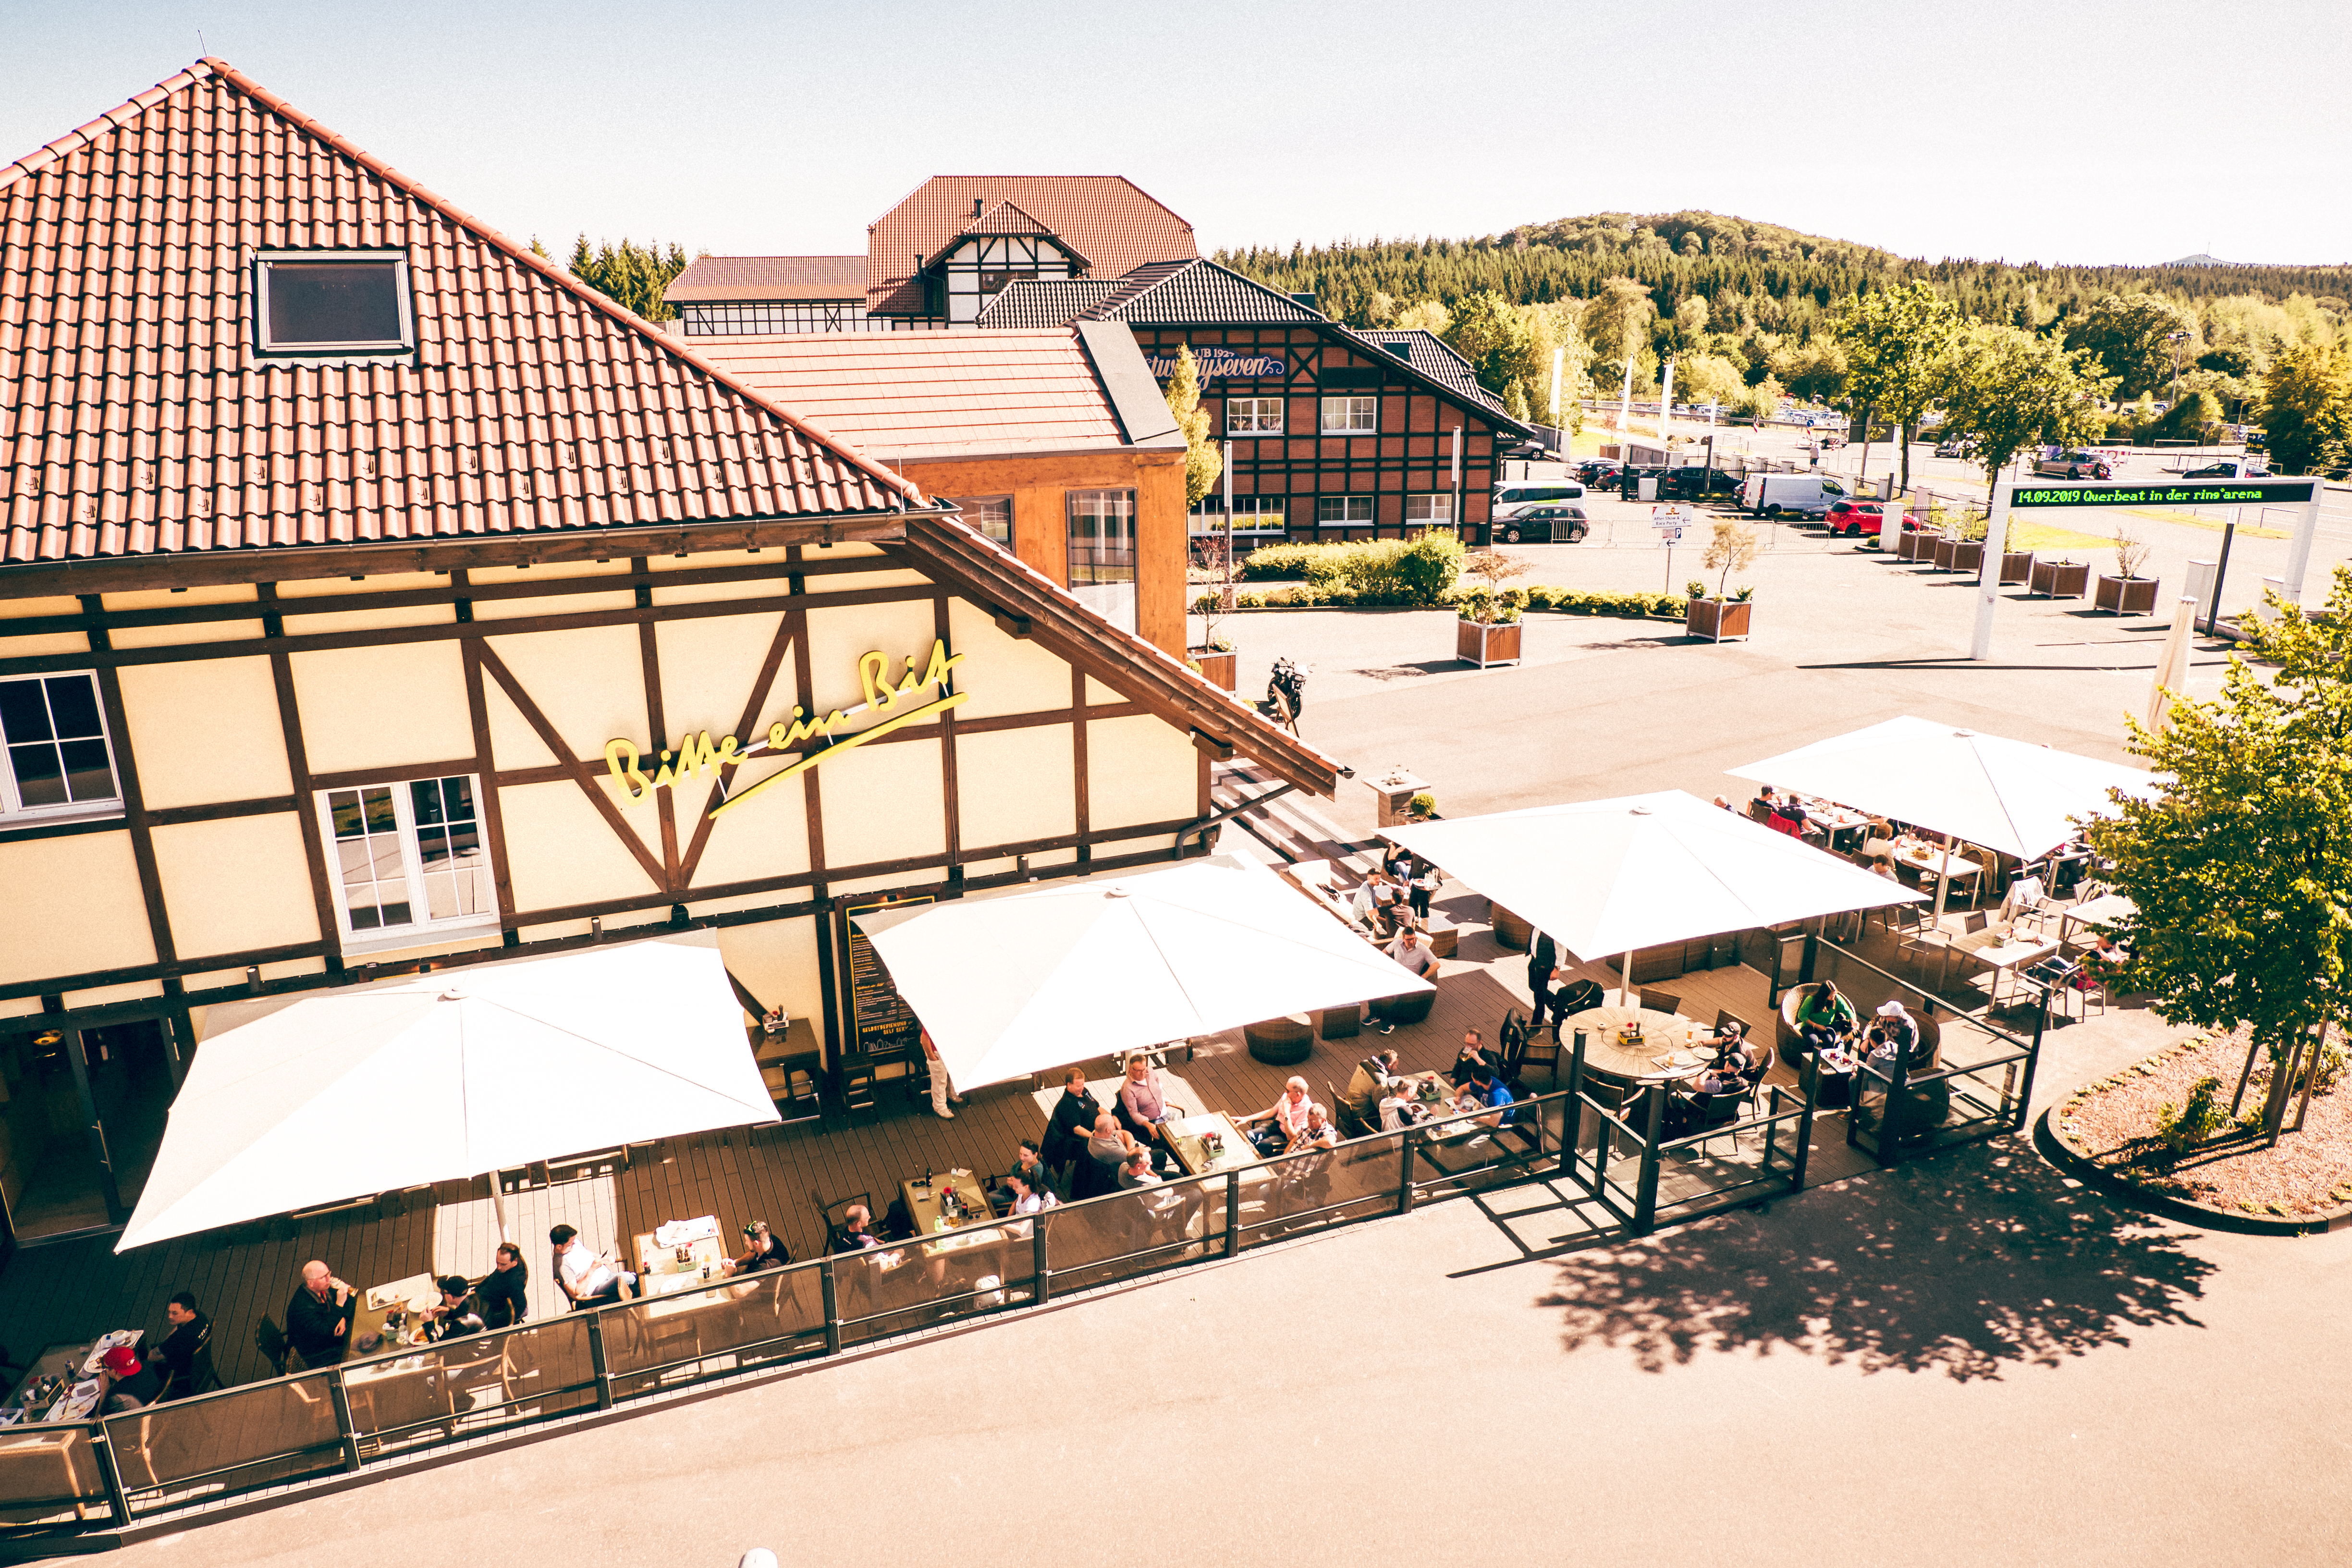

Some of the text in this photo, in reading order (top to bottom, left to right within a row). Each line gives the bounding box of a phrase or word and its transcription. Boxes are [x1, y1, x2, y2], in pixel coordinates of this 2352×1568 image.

[1194, 348, 1235, 358] UB 1927
[1146, 355, 1285, 391] twtyseven
[2018, 490, 2081, 503] 14.09.2019
[2083, 490, 2145, 502] Querbeat
[2149, 490, 2163, 501] in
[2166, 489, 2190, 501] der
[1676, 528, 1681, 538] P
[605, 638, 966, 807] Bitte ein Bit
